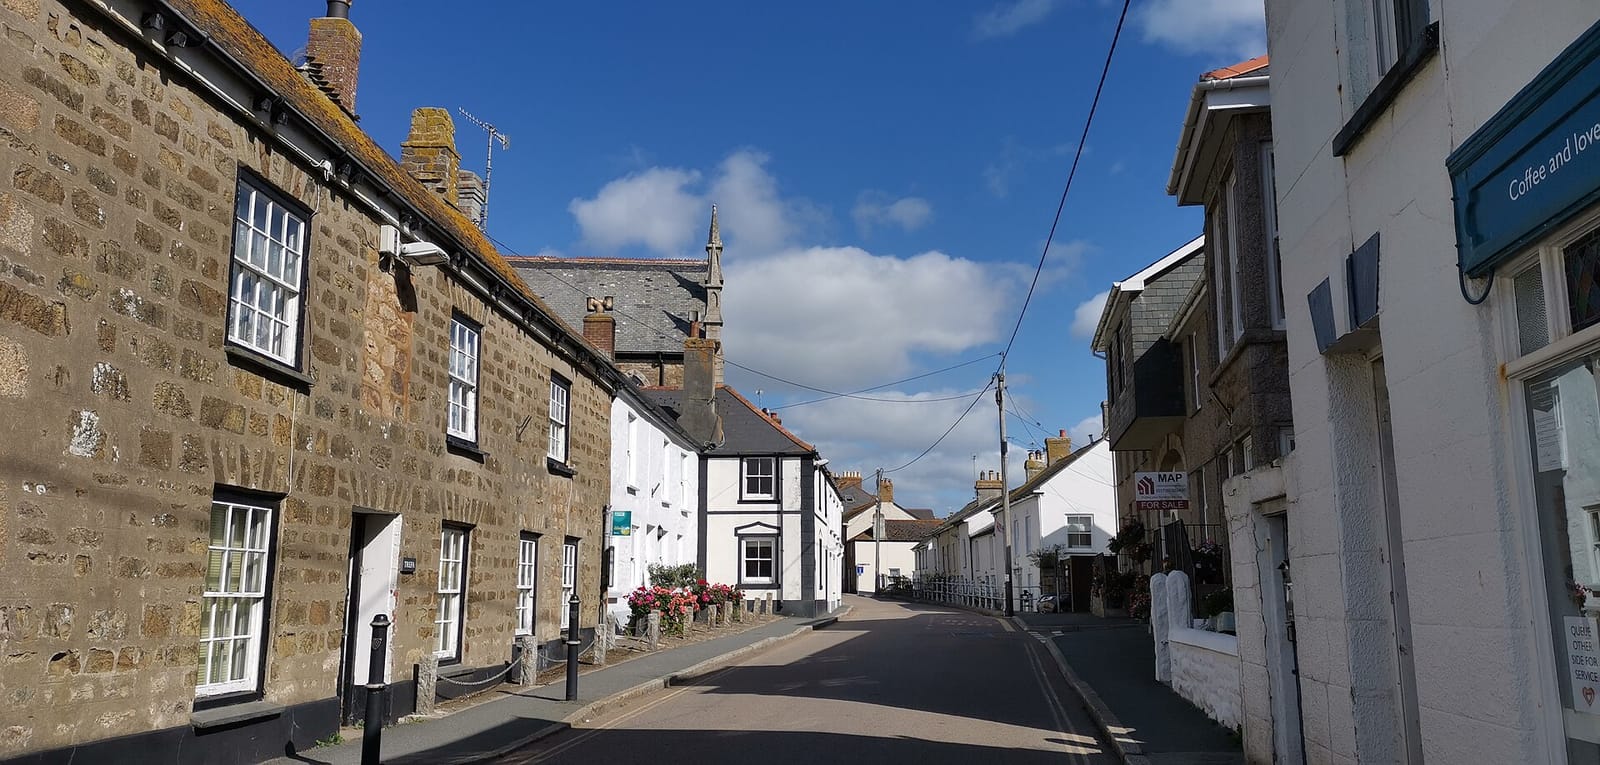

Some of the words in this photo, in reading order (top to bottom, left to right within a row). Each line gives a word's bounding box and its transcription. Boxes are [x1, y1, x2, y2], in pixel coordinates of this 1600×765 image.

[1509, 167, 1546, 201] Coffee
[1549, 138, 1571, 174] and
[1573, 123, 1600, 155] love
[1158, 473, 1183, 483] MAP
[1141, 501, 1160, 509] FOR
[1162, 501, 1184, 509] SALE
[1570, 625, 1592, 638] QUEUE
[1572, 640, 1593, 652] OTHER
[1571, 655, 1584, 666] SIDE
[1585, 656, 1599, 667] FOR
[1575, 669, 1598, 682] SERVICE
